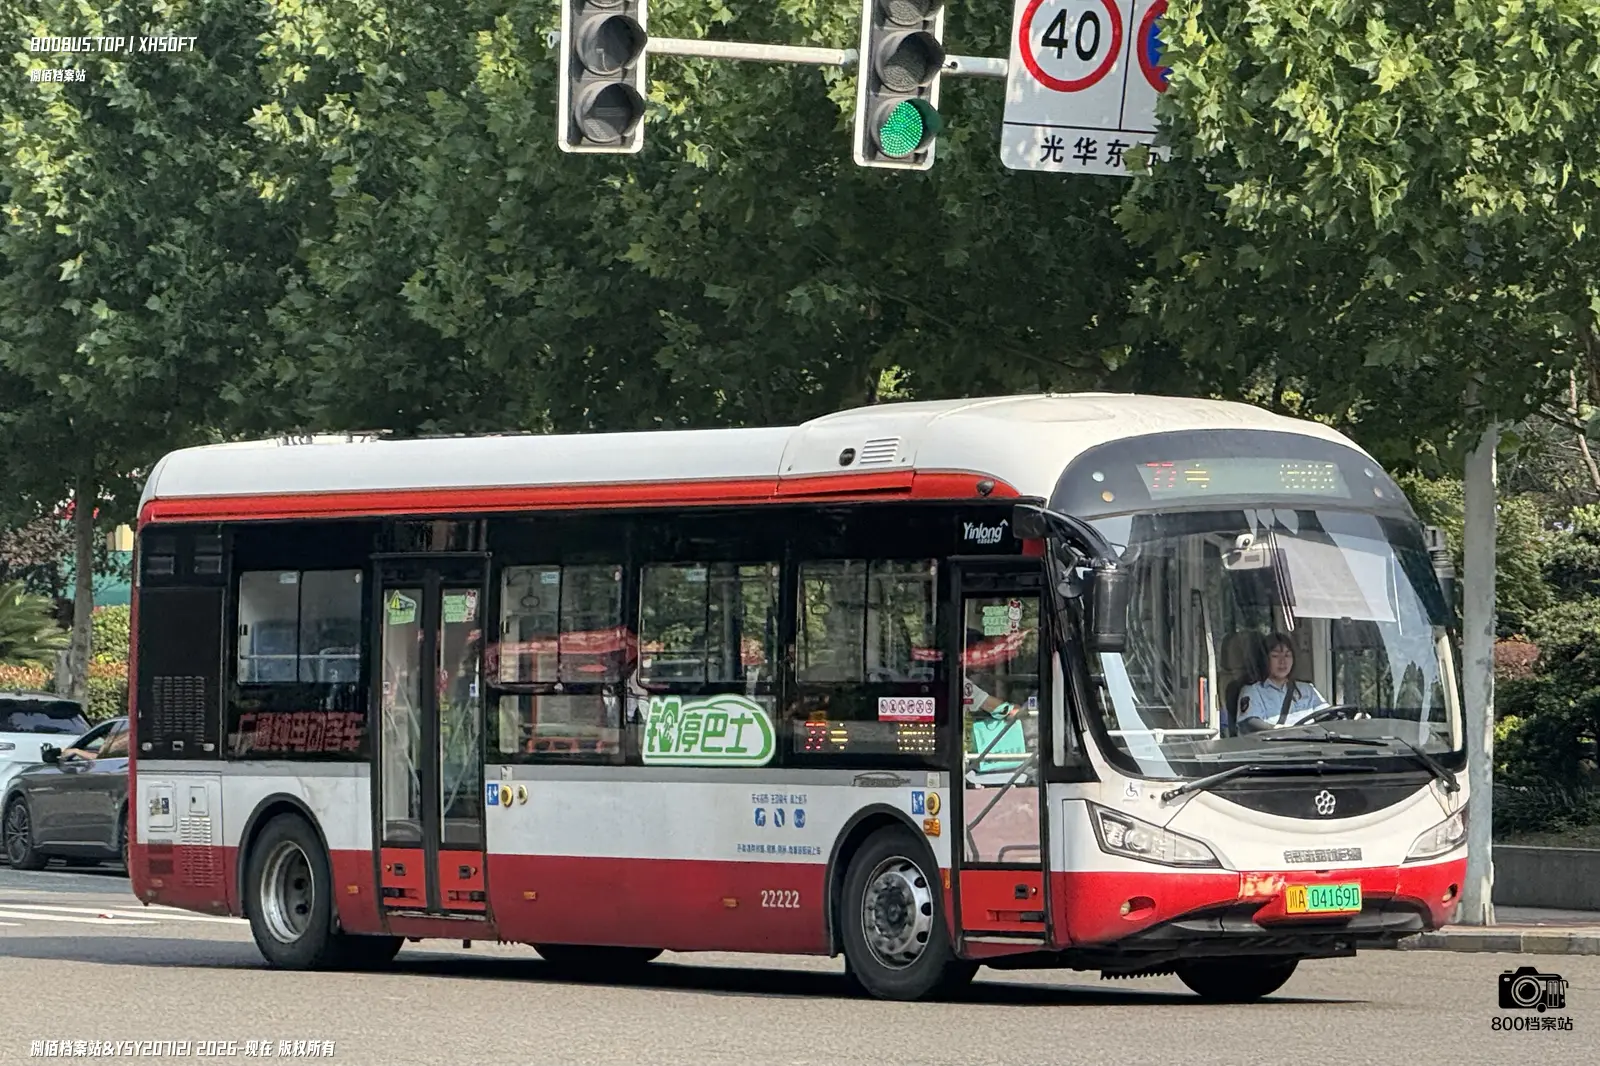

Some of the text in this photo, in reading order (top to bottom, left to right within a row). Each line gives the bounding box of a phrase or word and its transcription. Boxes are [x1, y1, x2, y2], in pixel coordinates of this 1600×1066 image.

[1041, 8, 1101, 62] 40
[963, 521, 1004, 544] Yinlong
[761, 889, 801, 909] 22222
[1311, 887, 1360, 908] 04169D
